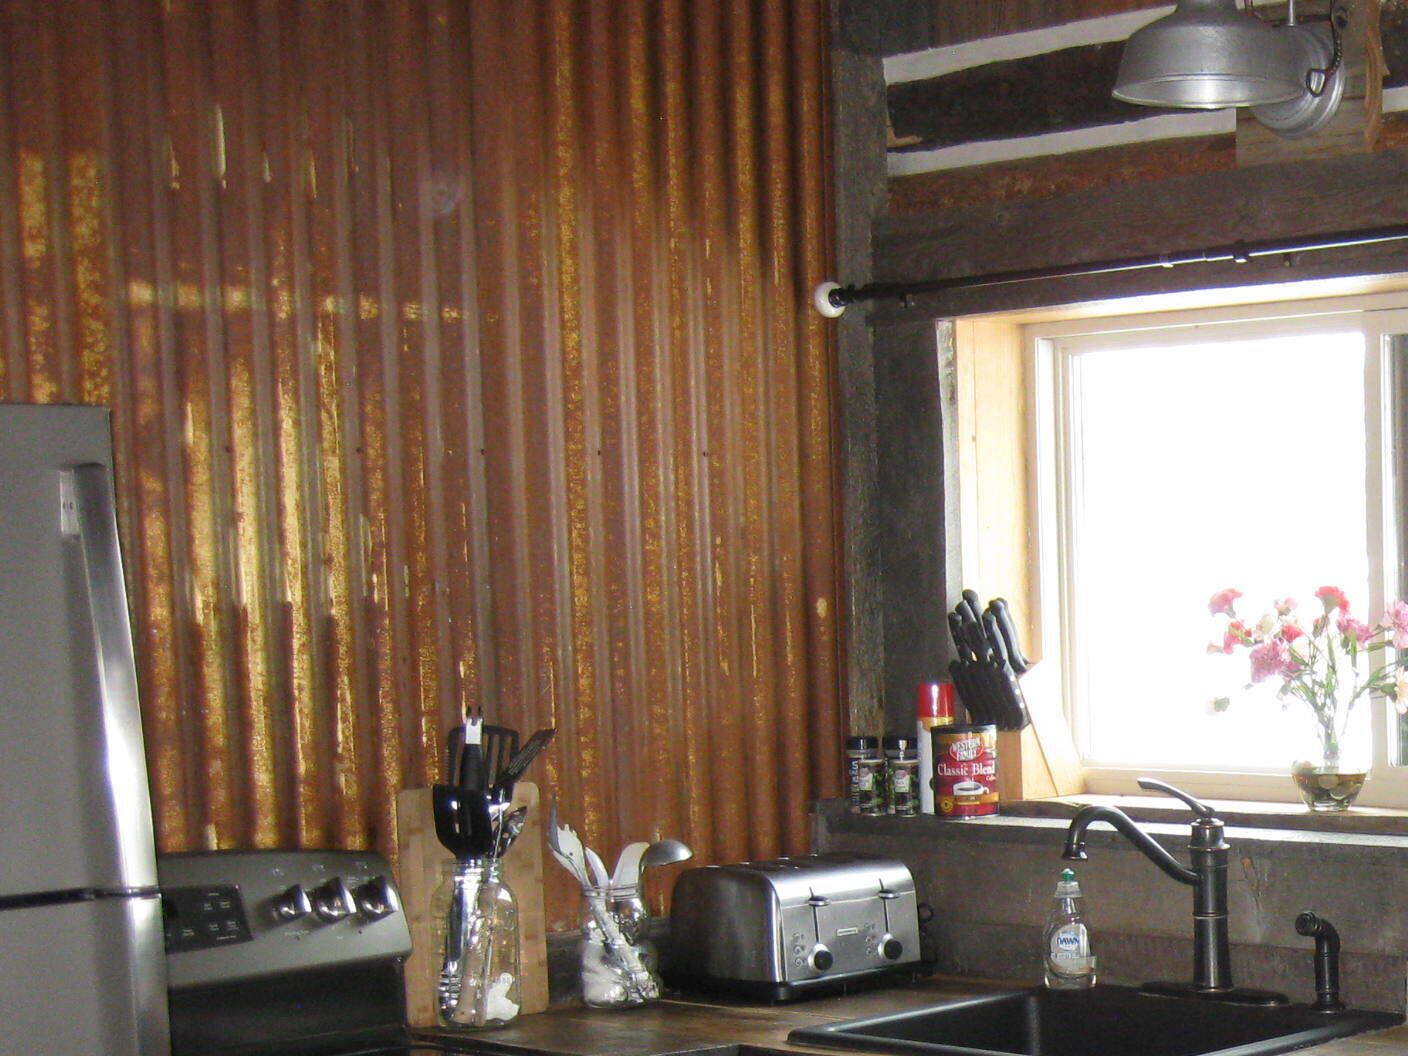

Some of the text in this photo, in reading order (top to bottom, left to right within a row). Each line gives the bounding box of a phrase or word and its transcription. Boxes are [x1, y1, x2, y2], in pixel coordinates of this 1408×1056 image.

[937, 759, 996, 776] Classic Blend
[1056, 936, 1080, 945] DAWN
